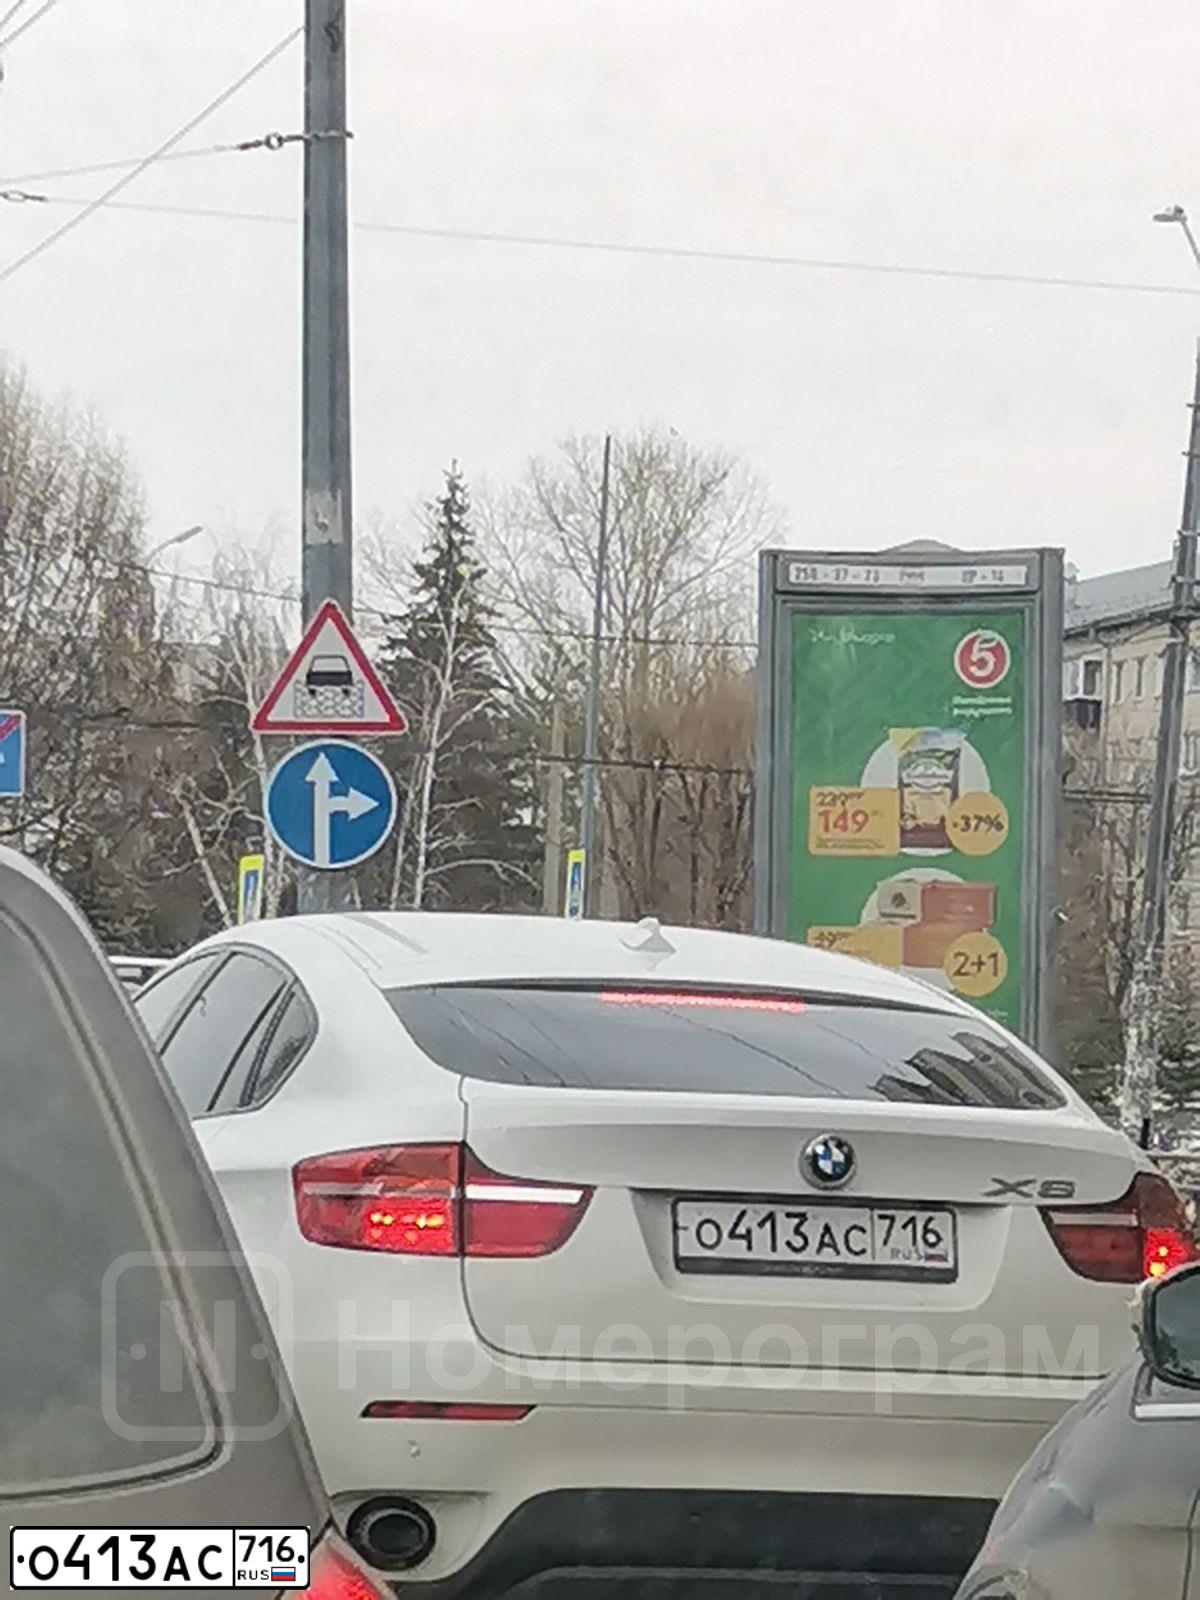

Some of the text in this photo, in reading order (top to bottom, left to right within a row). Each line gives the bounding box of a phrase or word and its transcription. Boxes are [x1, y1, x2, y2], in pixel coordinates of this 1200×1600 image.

[818, 809, 870, 833] 149
[952, 951, 999, 977] 2+1
[877, 1213, 943, 1248] 716
[890, 1247, 923, 1261] RUS
